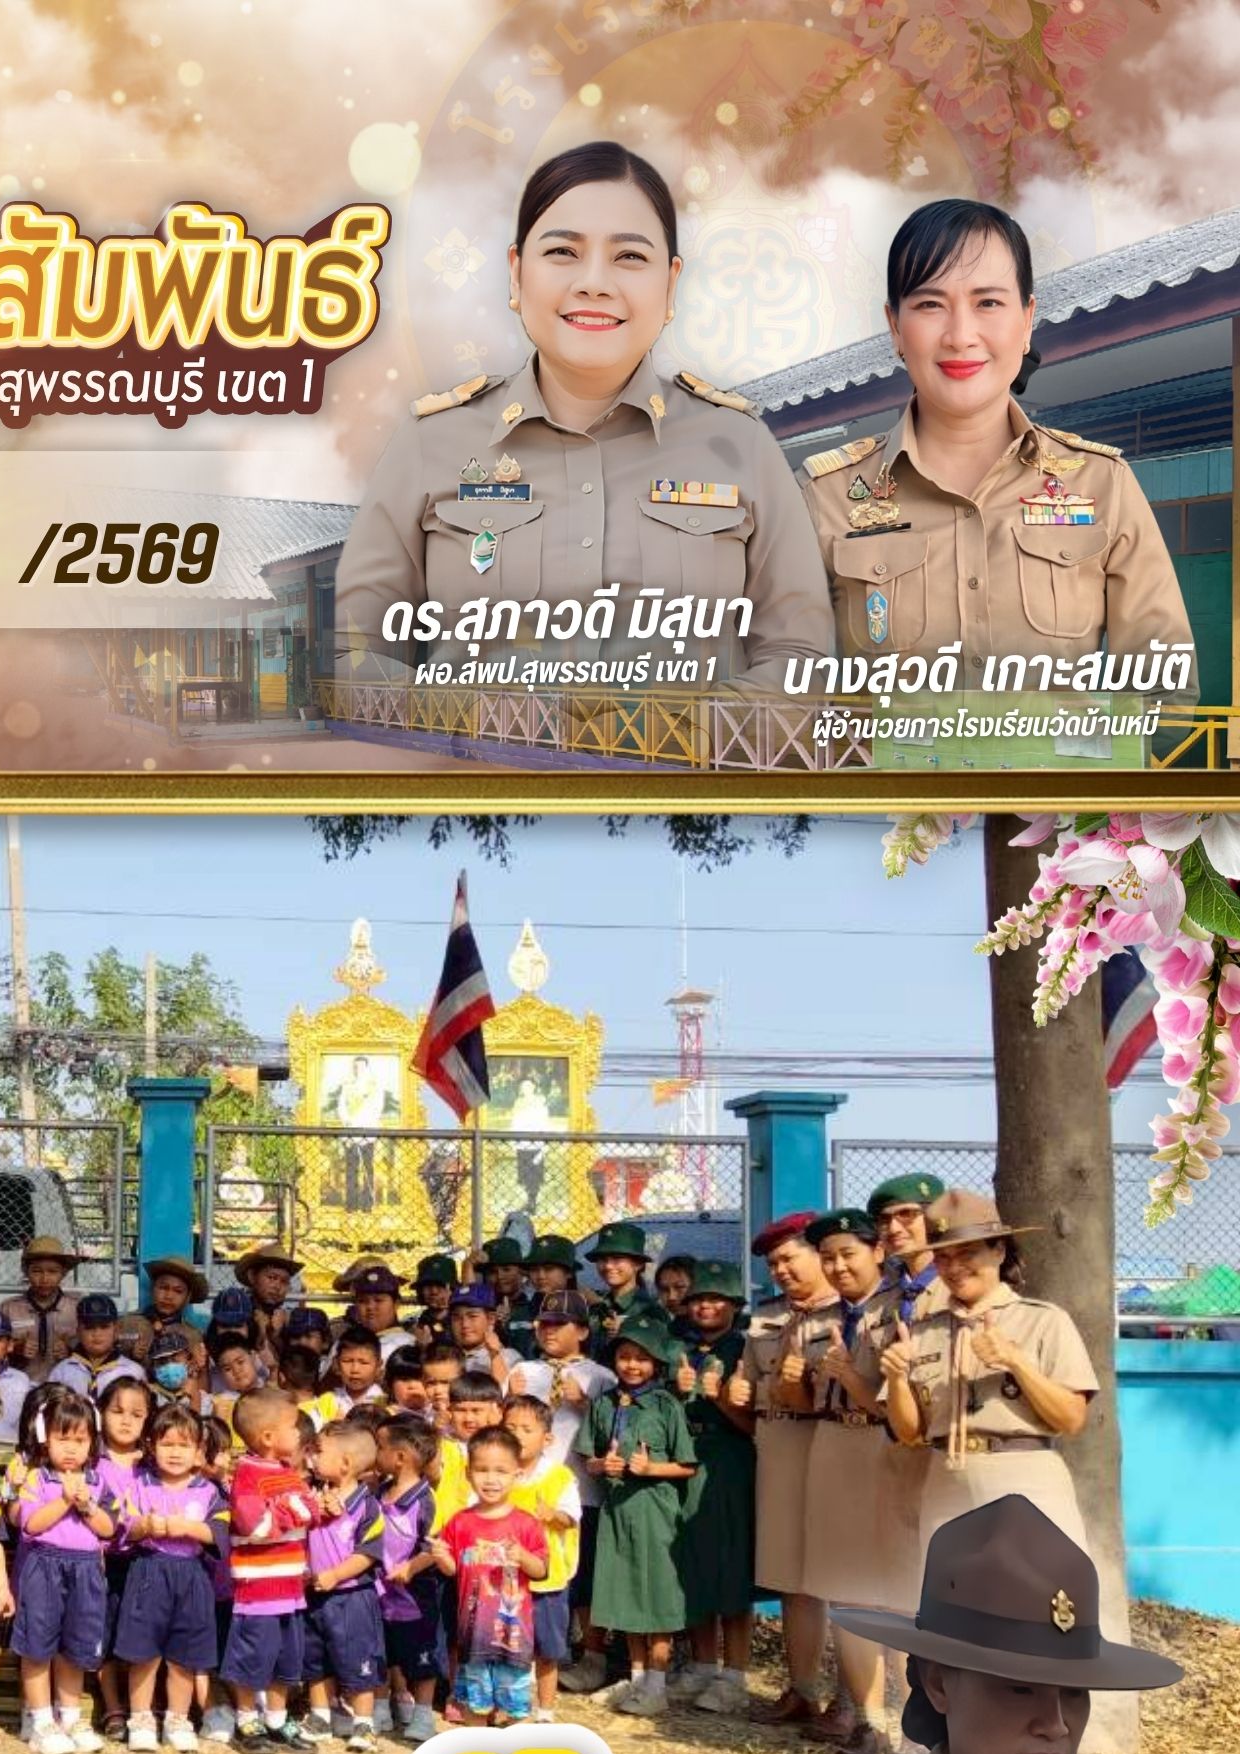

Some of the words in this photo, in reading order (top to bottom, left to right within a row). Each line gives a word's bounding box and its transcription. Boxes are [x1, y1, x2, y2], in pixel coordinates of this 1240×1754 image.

[218, 371, 286, 403] เขต
[301, 359, 314, 402] 1
[19, 522, 220, 585] /2569
[382, 583, 621, 656] ดร.สุภาวดี
[628, 588, 754, 654] มิสุนา
[415, 652, 650, 691] ผอ.สพป.สุพรรณบุรี
[655, 659, 699, 682] เขต
[706, 656, 717, 681] 1
[783, 641, 962, 706] นางสุวดี
[982, 639, 1195, 692] เกาะสมบัติ
[813, 701, 1161, 747] ผู้อำนวยการโรงเรียนวัดบ้านหมี่
